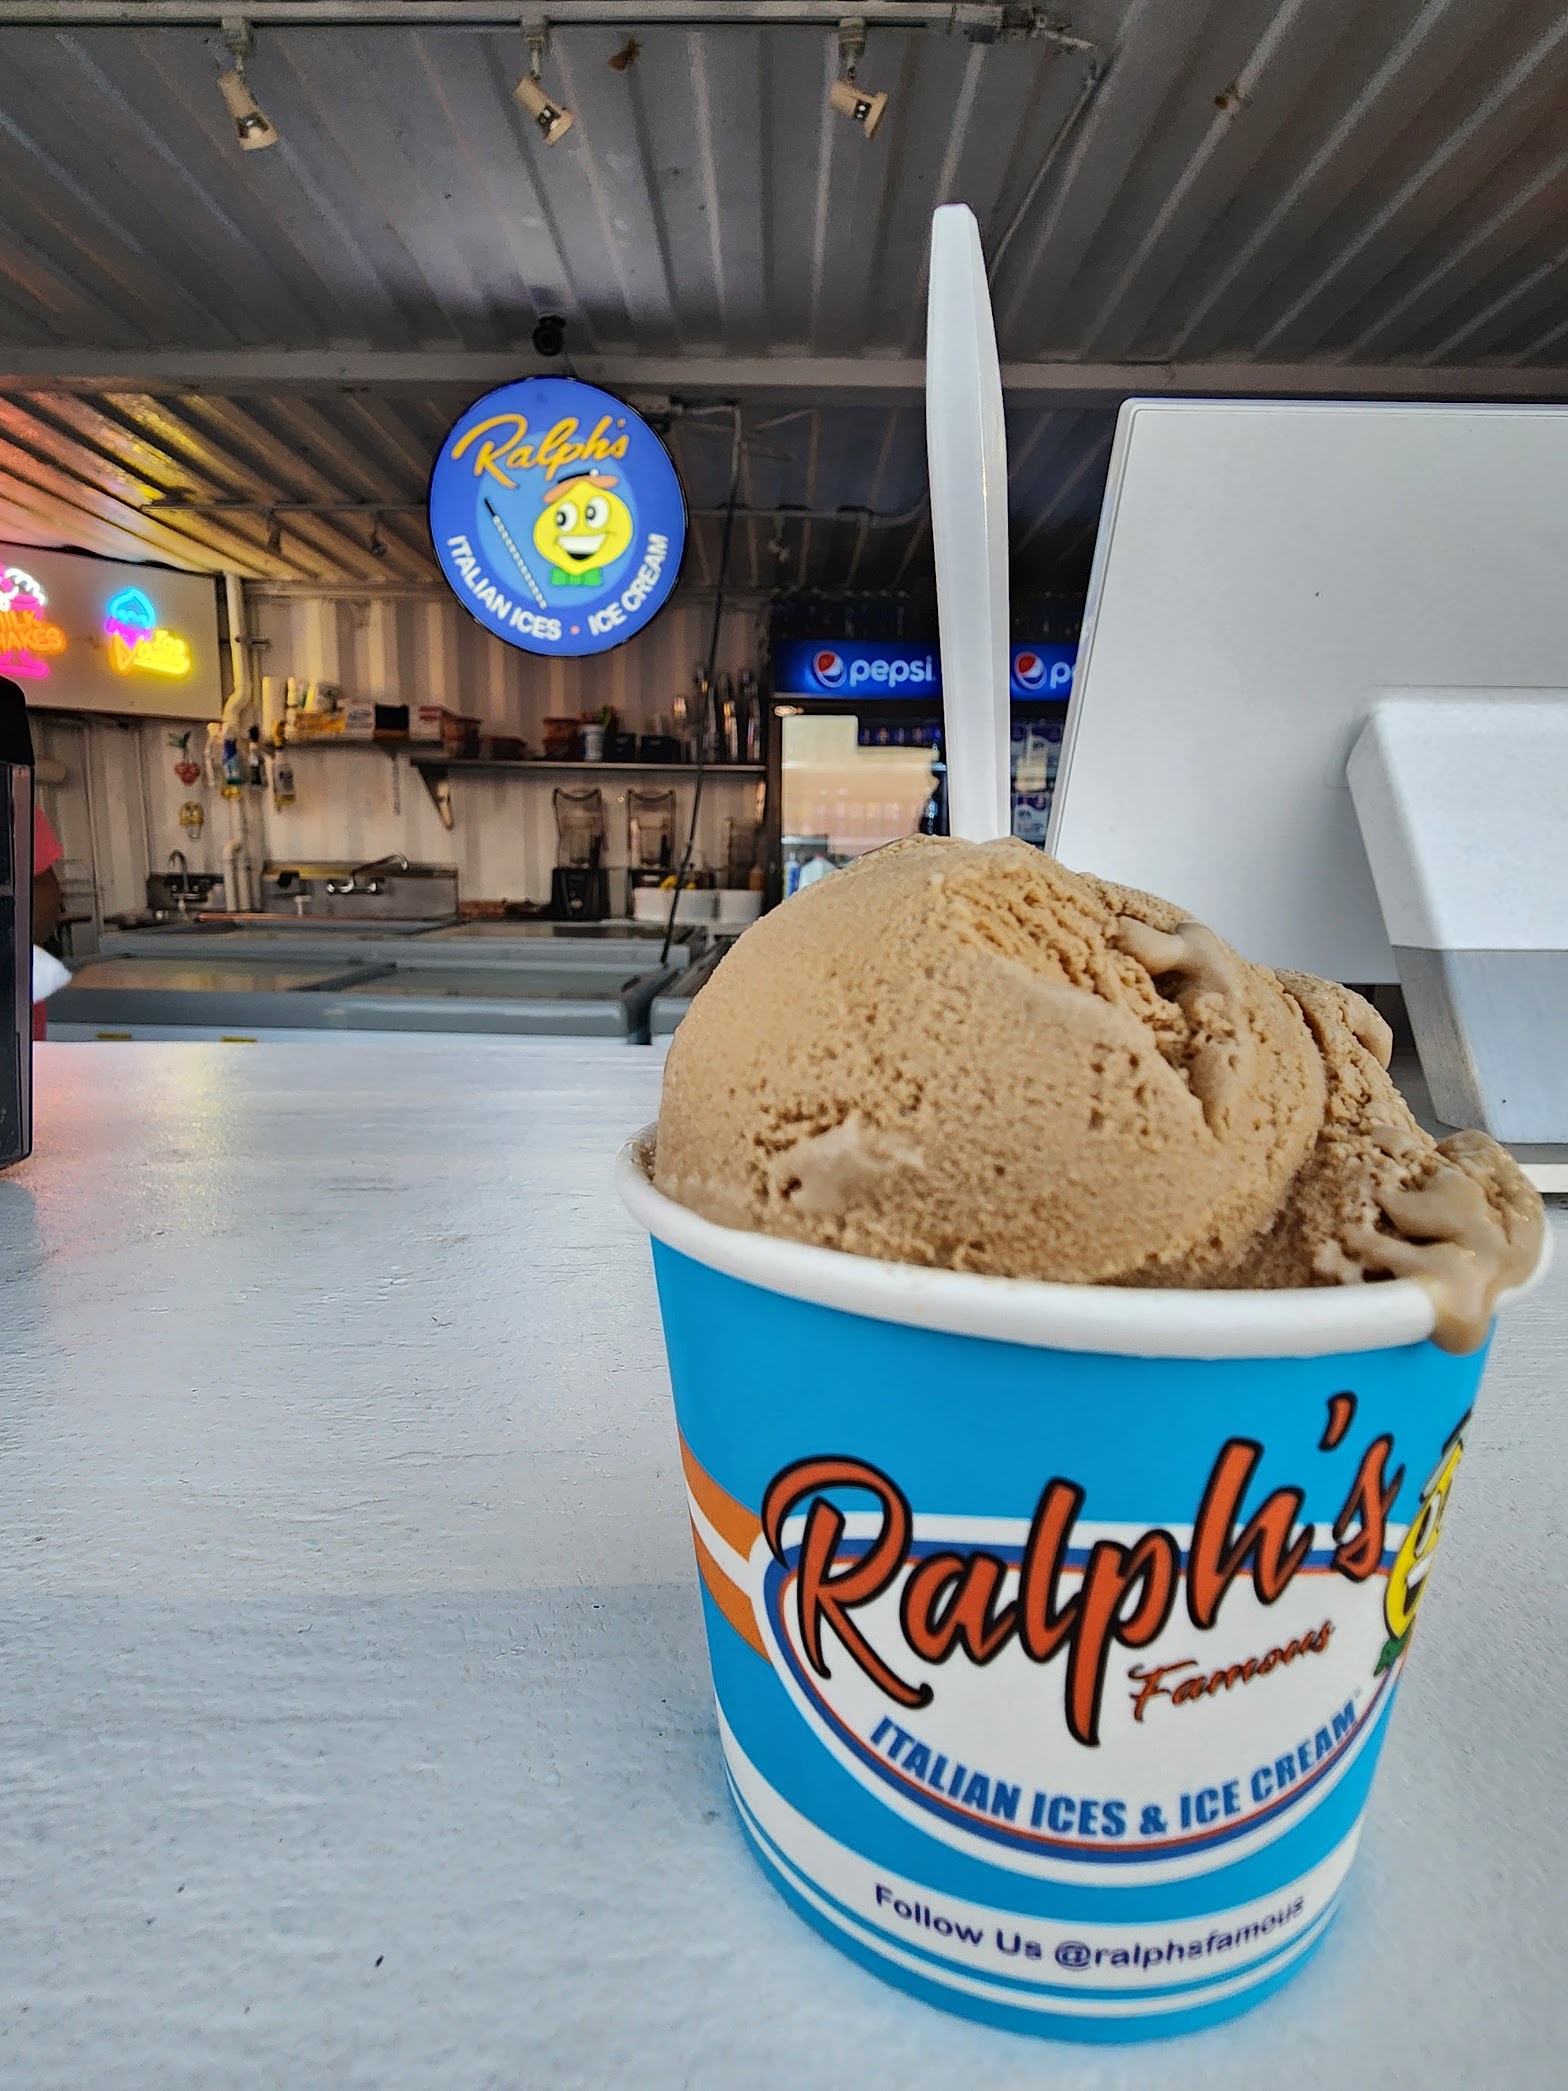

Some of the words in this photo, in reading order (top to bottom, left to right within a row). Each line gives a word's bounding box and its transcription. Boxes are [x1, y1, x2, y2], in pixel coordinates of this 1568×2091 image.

[451, 413, 630, 489] Ralph's
[447, 534, 513, 620] ITALIAN
[508, 606, 562, 641] ICES
[588, 602, 628, 636] ICE
[621, 533, 669, 612] CREAM
[0, 627, 63, 651] AKES
[850, 655, 934, 688] pepsi
[761, 1391, 1405, 1747] Ralph's
[1127, 1619, 1336, 1723] Famous
[869, 1715, 1022, 1822] ITALIAN
[1029, 1791, 1127, 1838] ICES
[1139, 1804, 1168, 1836] &
[1179, 1779, 1241, 1830] ICE
[1250, 1699, 1358, 1803] CREAM
[875, 1883, 984, 1947] Follow
[996, 1928, 1042, 1960] Us
[1054, 1894, 1305, 1973] @ralphsfamous
